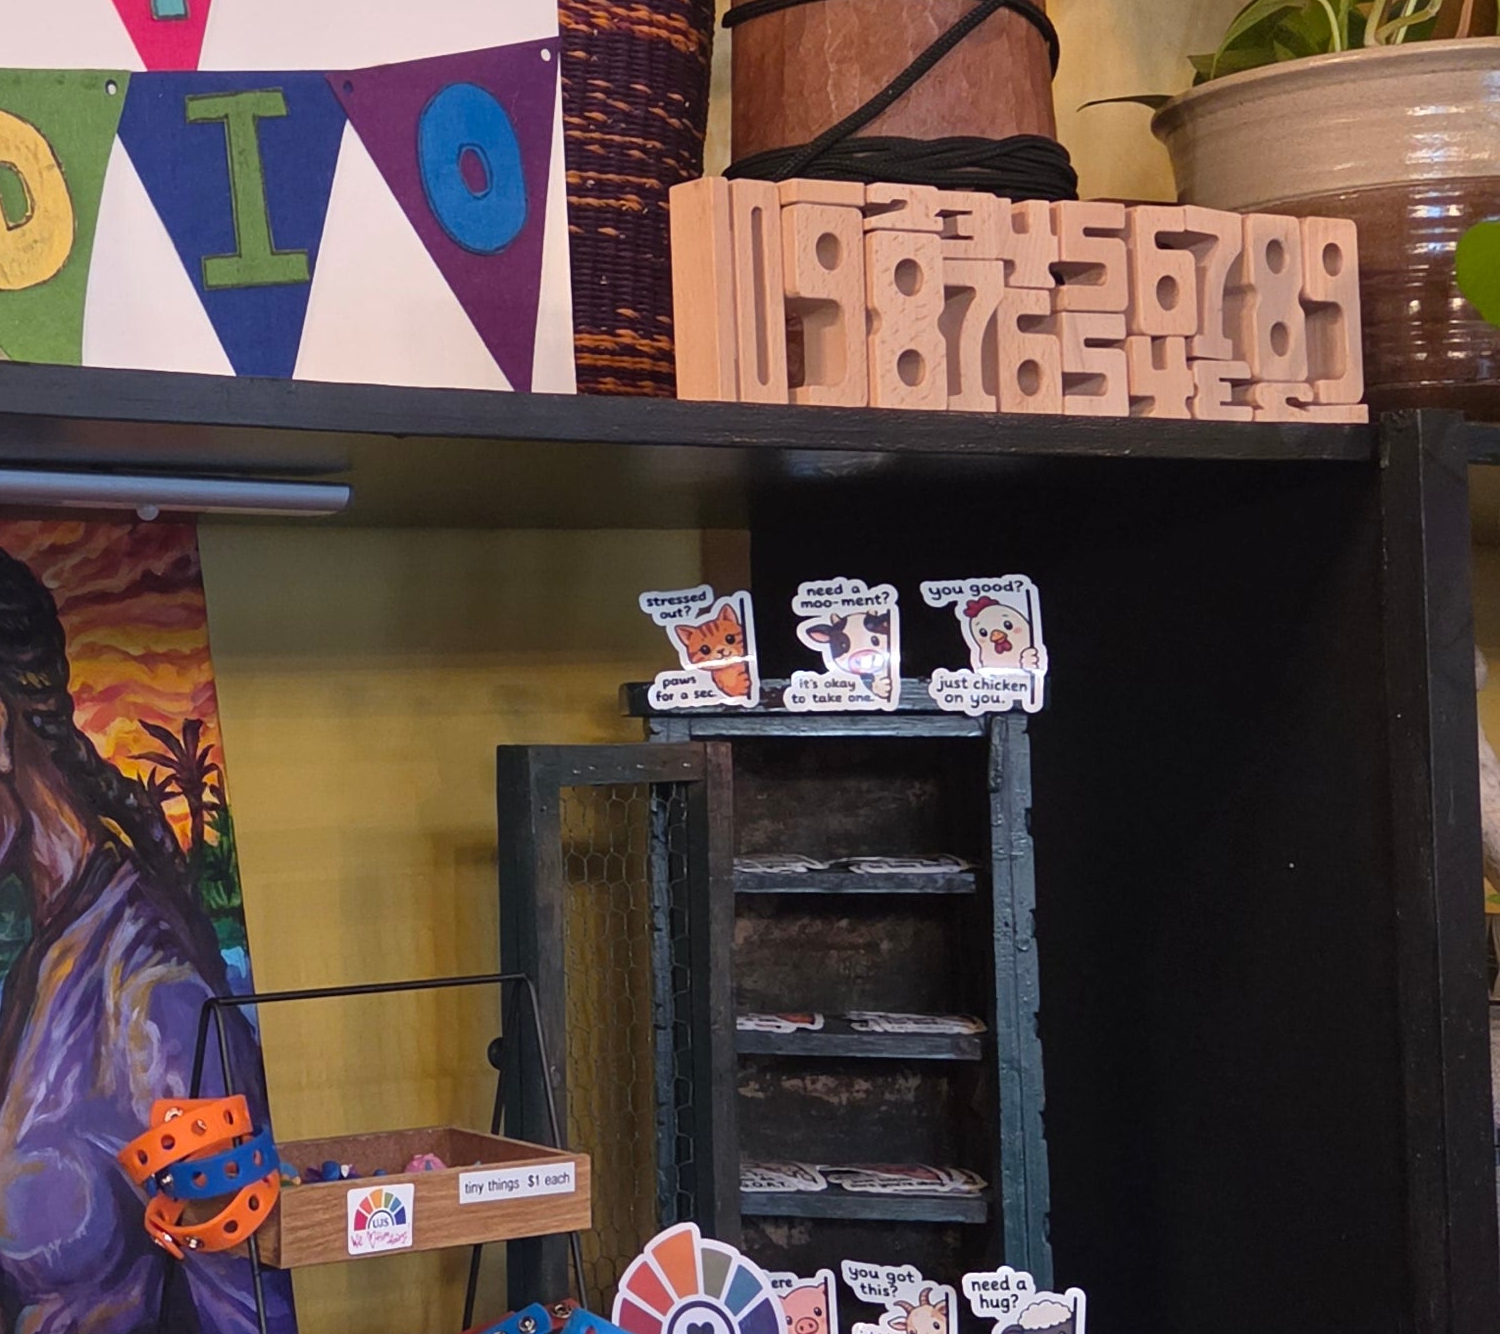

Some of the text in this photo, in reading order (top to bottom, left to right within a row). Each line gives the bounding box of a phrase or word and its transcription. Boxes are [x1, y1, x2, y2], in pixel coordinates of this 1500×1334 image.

[807, 584, 843, 596] need
[929, 580, 1024, 600] you good?
[646, 591, 706, 607] stressed
[801, 592, 889, 608] moo-ment?
[660, 606, 691, 619] out?
[663, 676, 696, 689] paws
[799, 678, 855, 691] it's okay
[936, 676, 1027, 692] just chicken
[656, 691, 673, 701] for
[792, 694, 805, 703] to
[813, 693, 842, 703] take
[945, 694, 1005, 708] on you.
[465, 1172, 570, 1195] tiny things $1 each
[848, 1267, 915, 1288] you got
[971, 1275, 1027, 1291] need a
[859, 1283, 898, 1298] this?
[980, 1293, 1019, 1313] hug?
